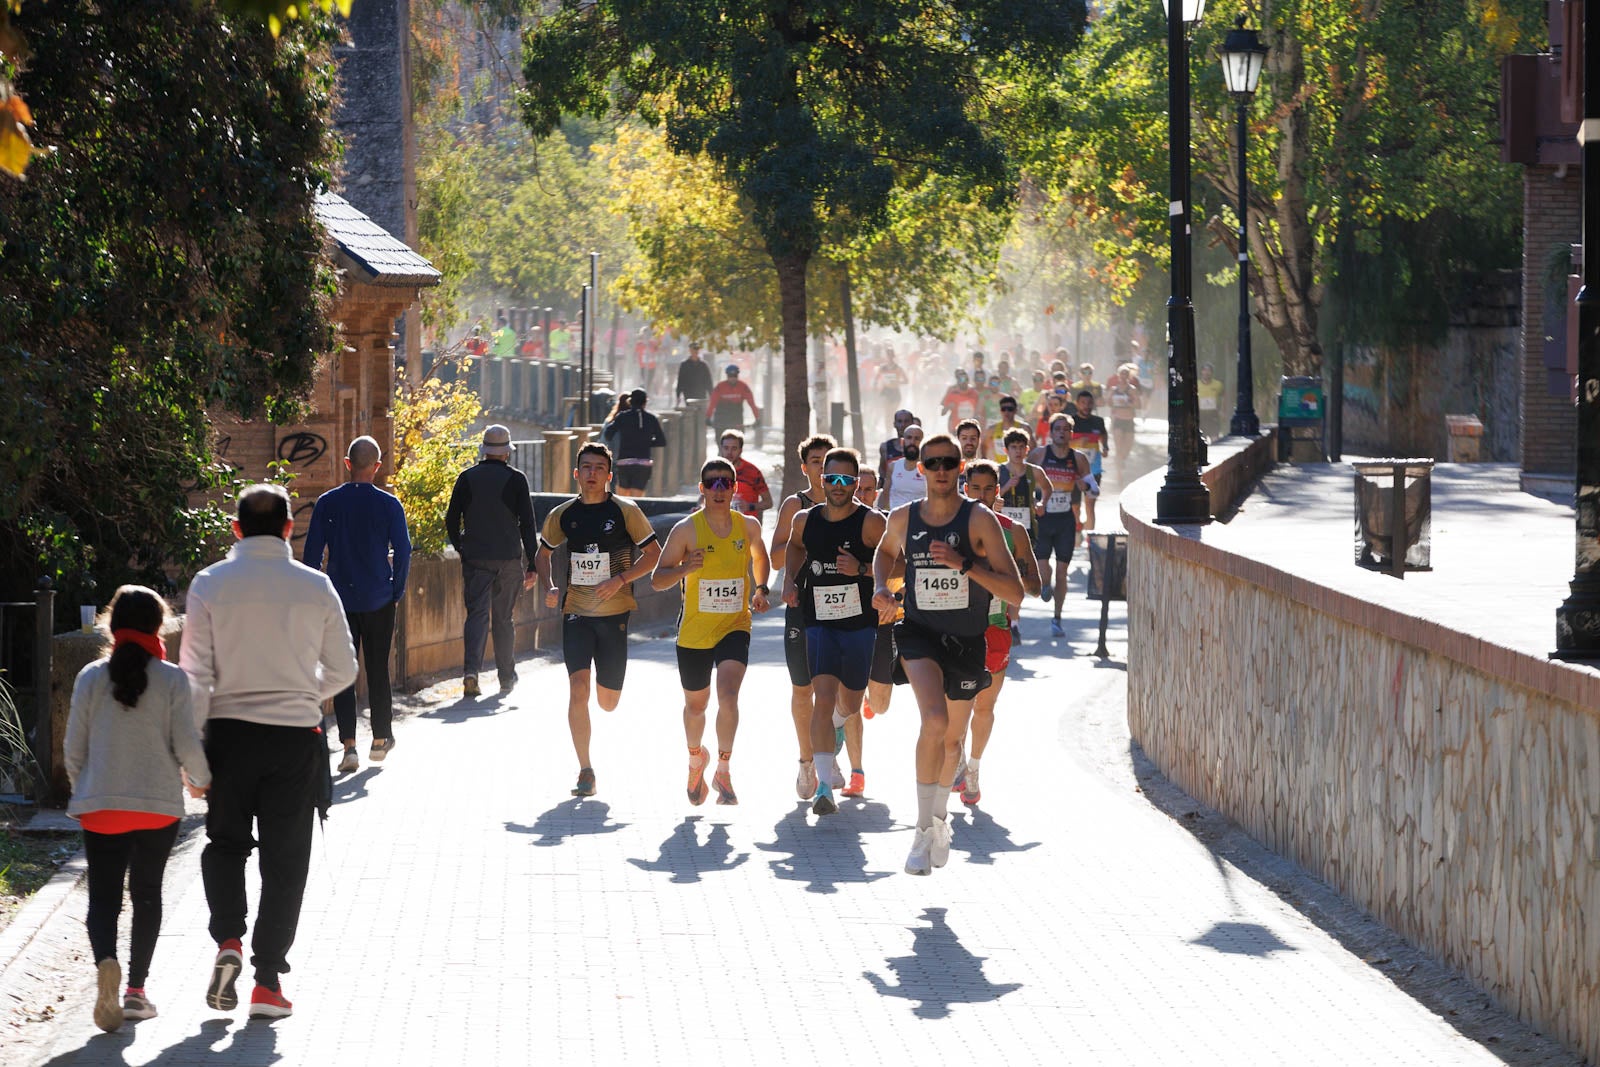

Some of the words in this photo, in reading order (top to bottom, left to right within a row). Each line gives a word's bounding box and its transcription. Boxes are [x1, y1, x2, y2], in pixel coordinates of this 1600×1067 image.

[1008, 511, 1023, 519] 793
[576, 560, 601, 570] 1497
[923, 578, 959, 590] 1469
[706, 586, 737, 597] 1154
[824, 592, 847, 604] 257
